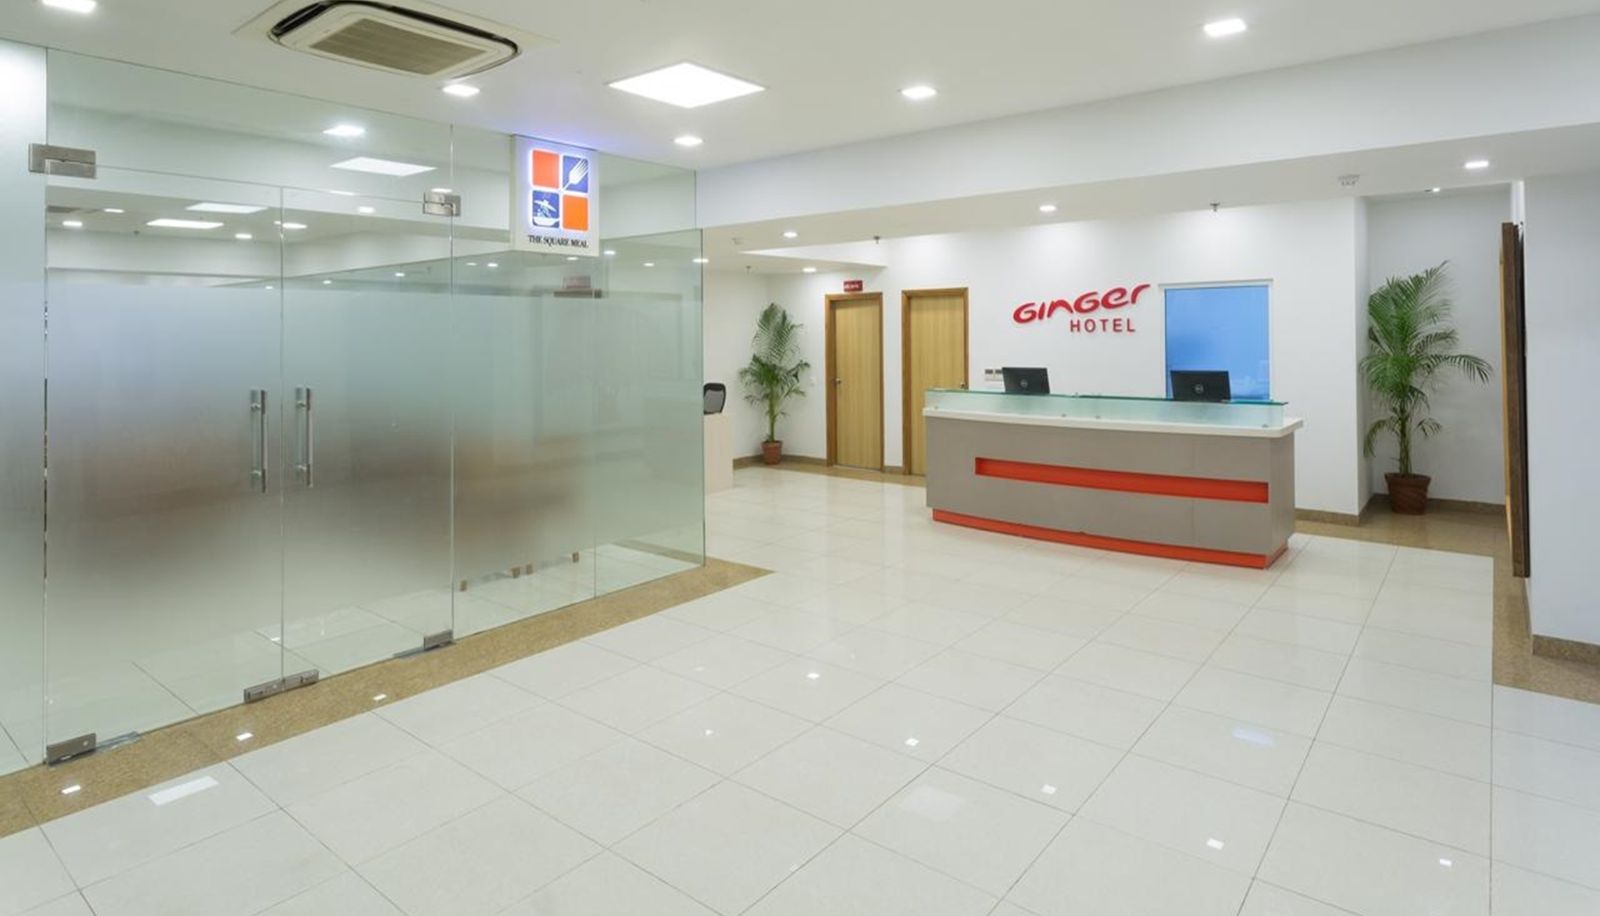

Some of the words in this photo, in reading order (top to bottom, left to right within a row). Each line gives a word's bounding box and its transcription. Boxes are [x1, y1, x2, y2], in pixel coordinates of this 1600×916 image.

[528, 235, 541, 244] THE
[543, 236, 569, 247] SQUARE
[570, 239, 589, 249] MEAL
[1070, 318, 1136, 333] HOTEL
